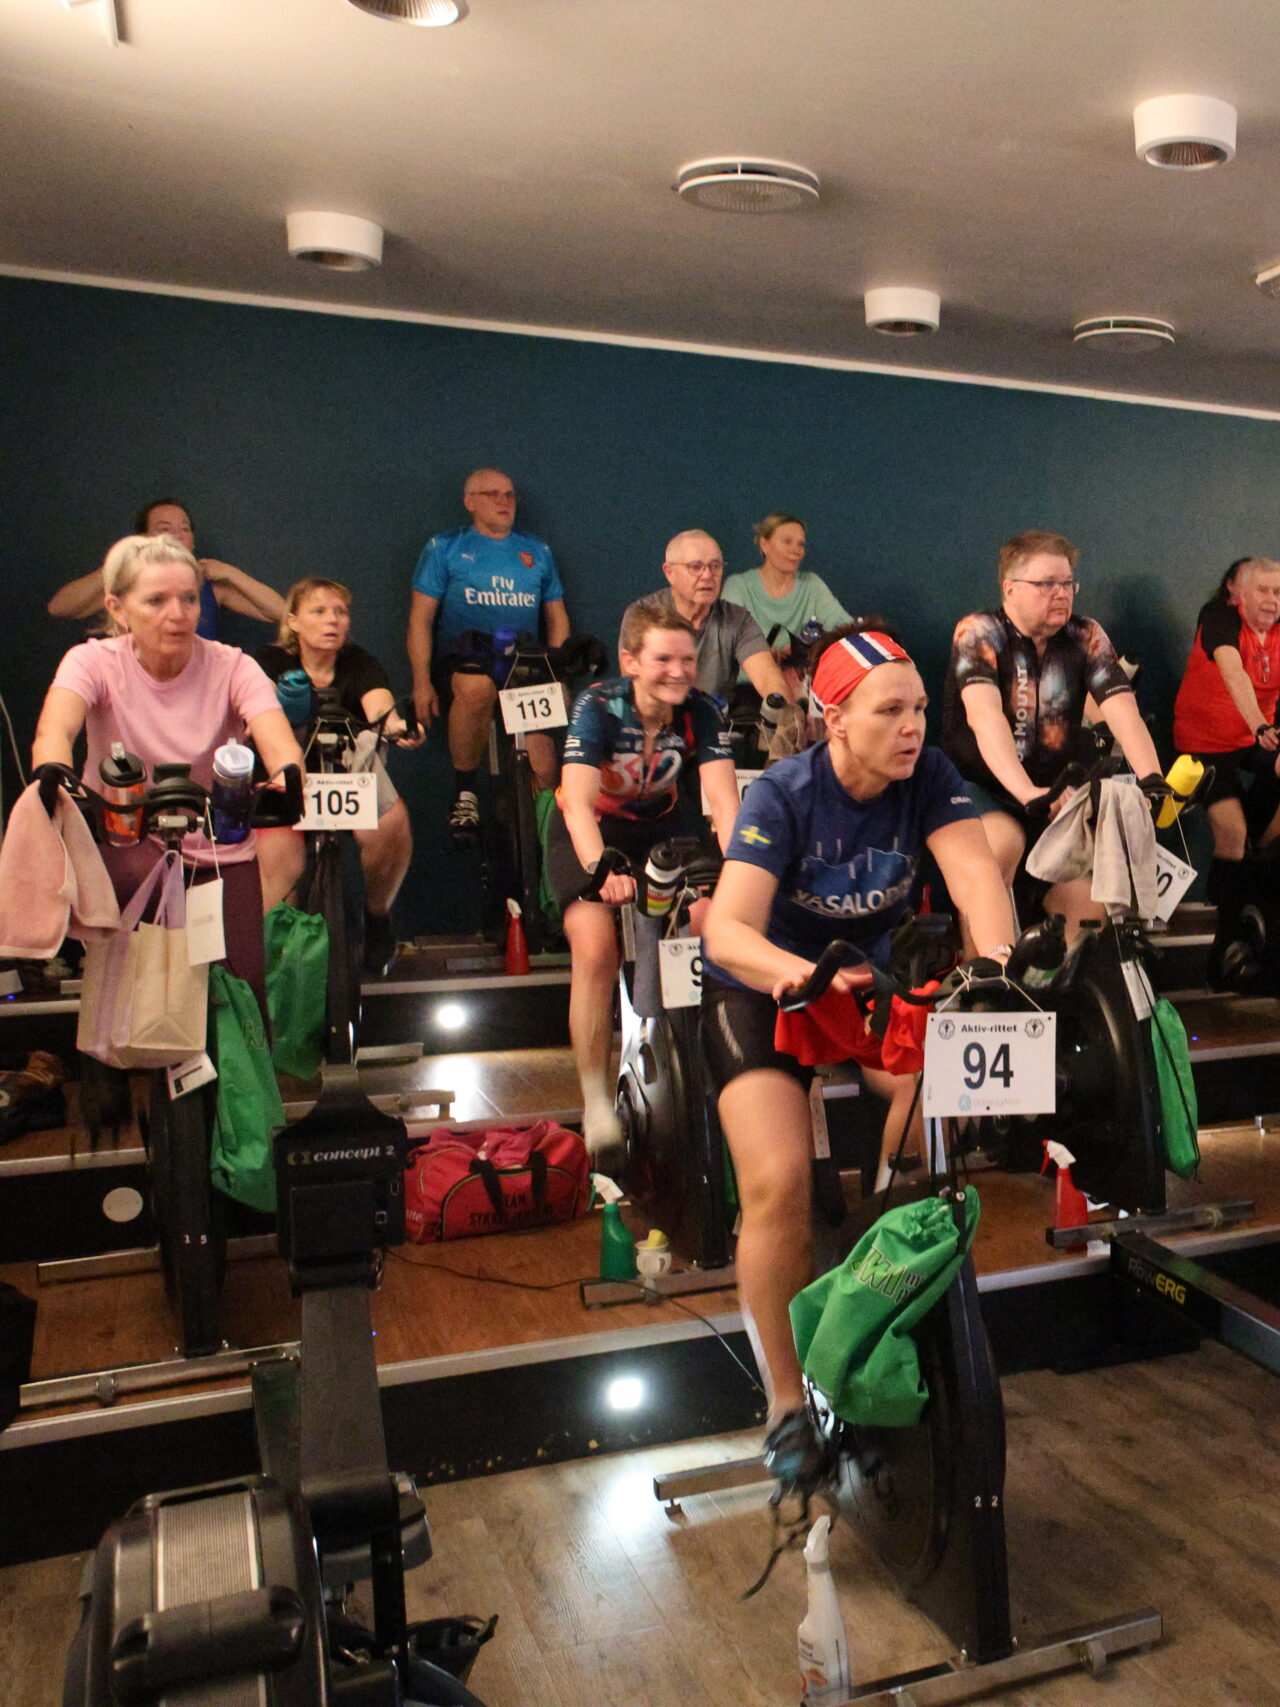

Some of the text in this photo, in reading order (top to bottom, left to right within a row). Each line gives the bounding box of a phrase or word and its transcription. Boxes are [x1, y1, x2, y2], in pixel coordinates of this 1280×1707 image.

[491, 575, 515, 591] Fly
[464, 587, 536, 607] Emirates
[516, 697, 552, 720] 113
[1014, 666, 1028, 736] MOUNT
[311, 790, 360, 815] 105
[961, 1024, 1018, 1033] Aktiv-rittet
[963, 1042, 1014, 1090] 94
[313, 1146, 382, 1163] concept
[385, 1145, 396, 1157] 2
